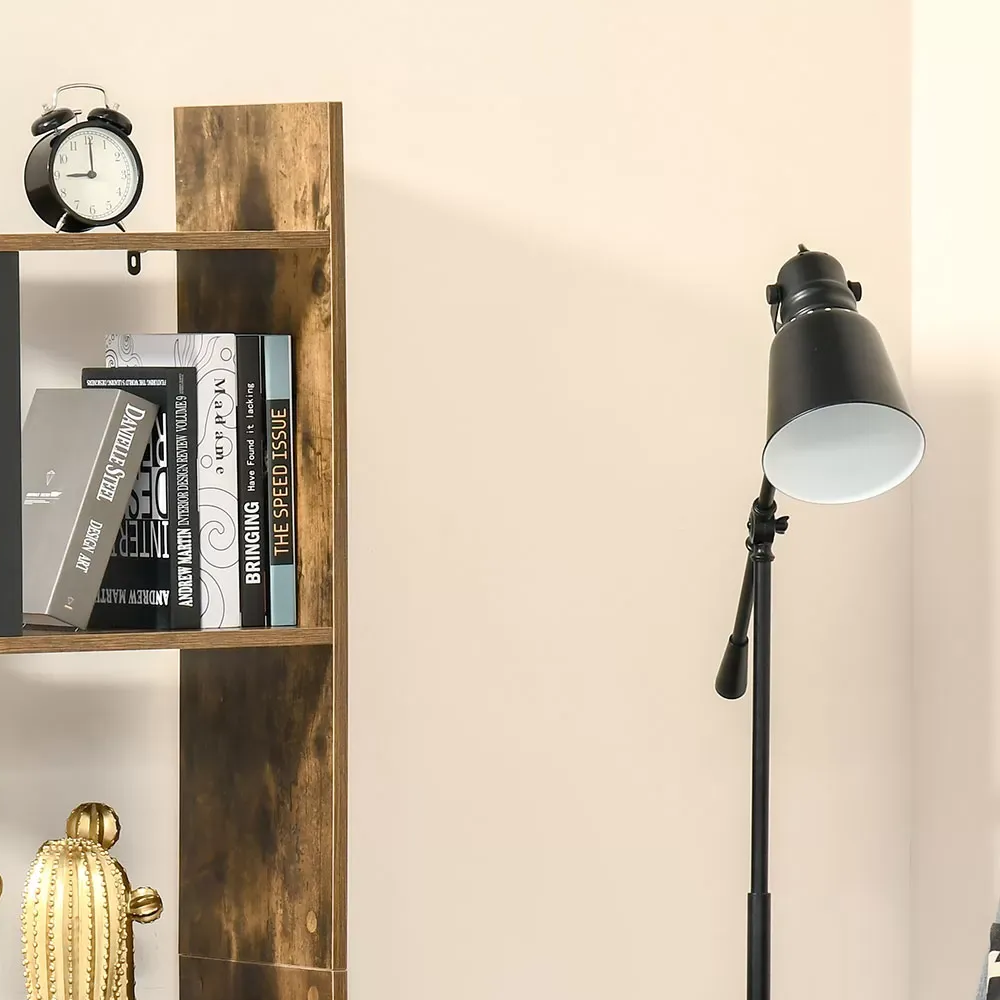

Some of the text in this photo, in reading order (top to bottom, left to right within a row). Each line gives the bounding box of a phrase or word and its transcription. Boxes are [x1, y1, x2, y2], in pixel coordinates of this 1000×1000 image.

[59, 153, 68, 164] 10
[70, 141, 77, 151] 11
[103, 140, 107, 150] 1
[114, 152, 120, 162] 2
[54, 170, 60, 180] 9
[60, 188, 67, 197] 8
[74, 200, 80, 210] 7
[106, 201, 112, 210] 5
[89, 205, 96, 214] 6
[174, 401, 188, 432] VOLUME
[213, 378, 227, 475] Madame
[96, 403, 146, 503] DANIELLE STEEL
[175, 434, 188, 463] REVIEW
[176, 463, 189, 491] DESIGN
[243, 382, 261, 584] BRINGING Have Found it lacking
[271, 407, 290, 557] THE SPEED ISSUE
[126, 467, 169, 520] DES
[177, 491, 190, 526] INTERIOR
[75, 519, 103, 574] DESIGN ART
[111, 520, 170, 559] INTER
[176, 527, 192, 565] MARTIN
[128, 589, 170, 606] ANDREW
[177, 566, 194, 607] ANDREW
